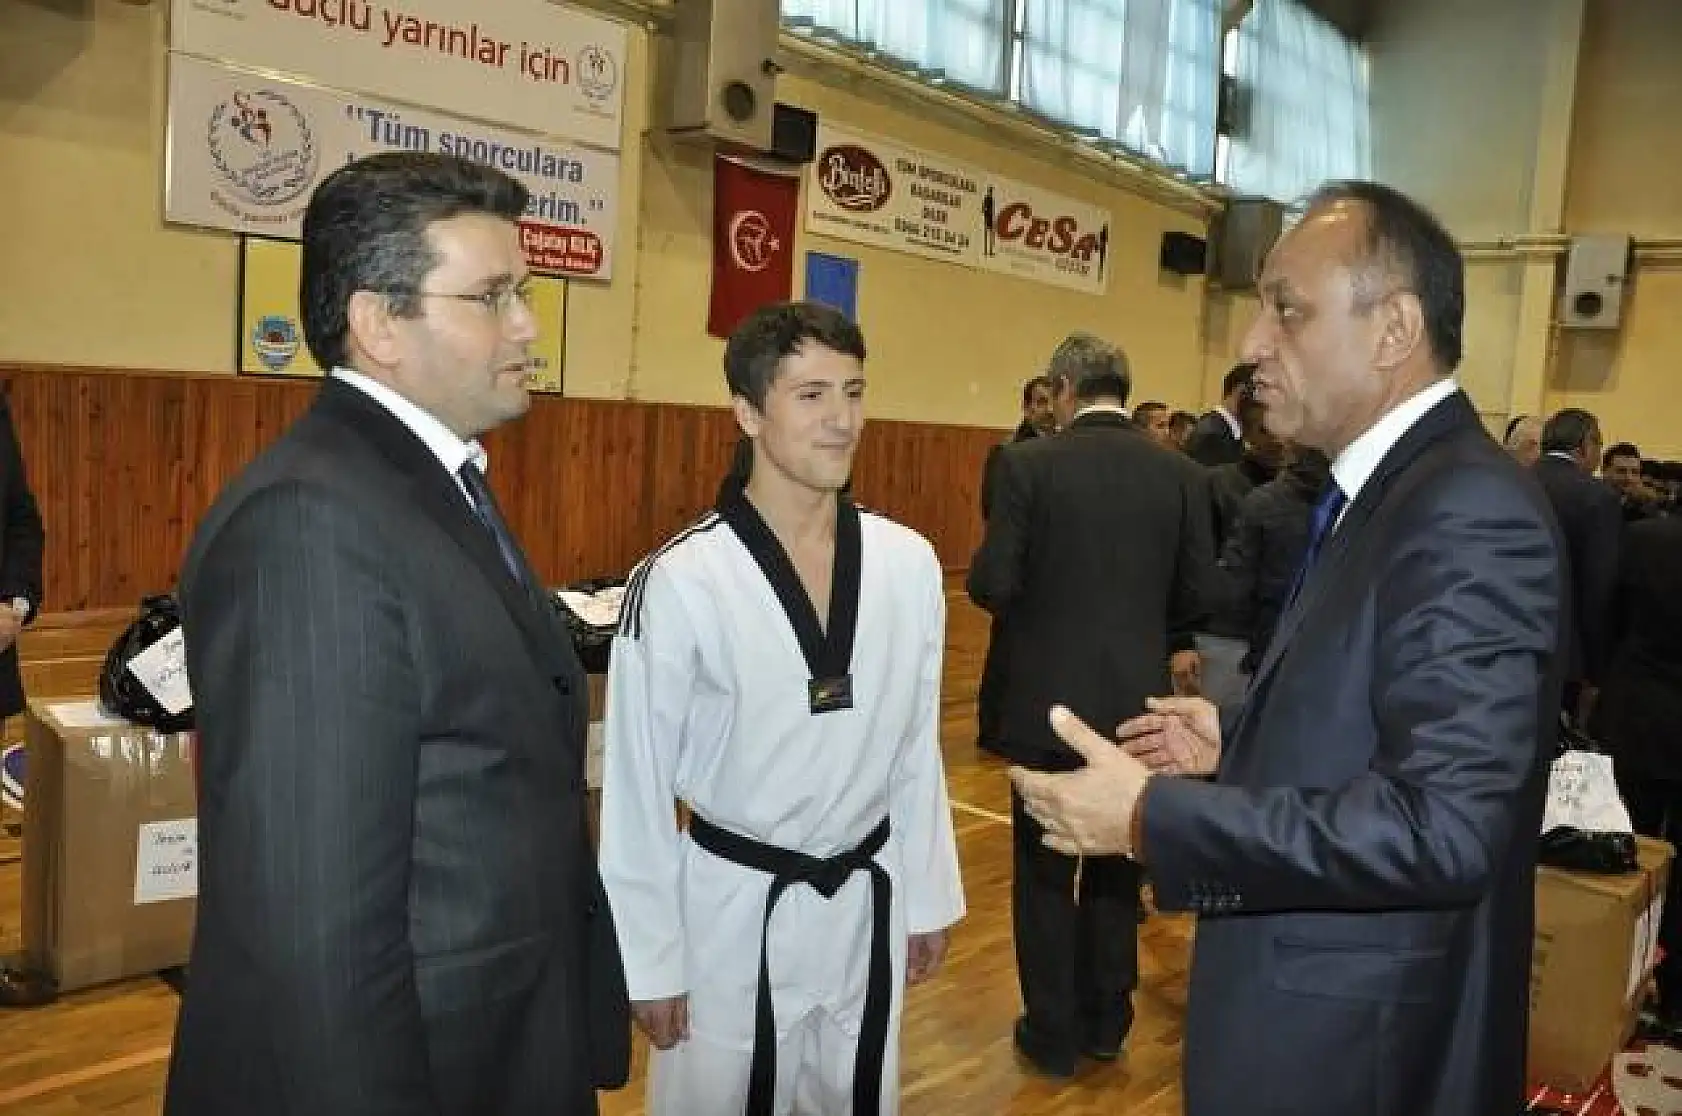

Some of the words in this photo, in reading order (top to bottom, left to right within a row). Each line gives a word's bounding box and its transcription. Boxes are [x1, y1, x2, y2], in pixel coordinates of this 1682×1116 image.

[381, 10, 511, 67] yarınlar
[520, 40, 570, 85] için
[438, 131, 584, 183] sporculara
